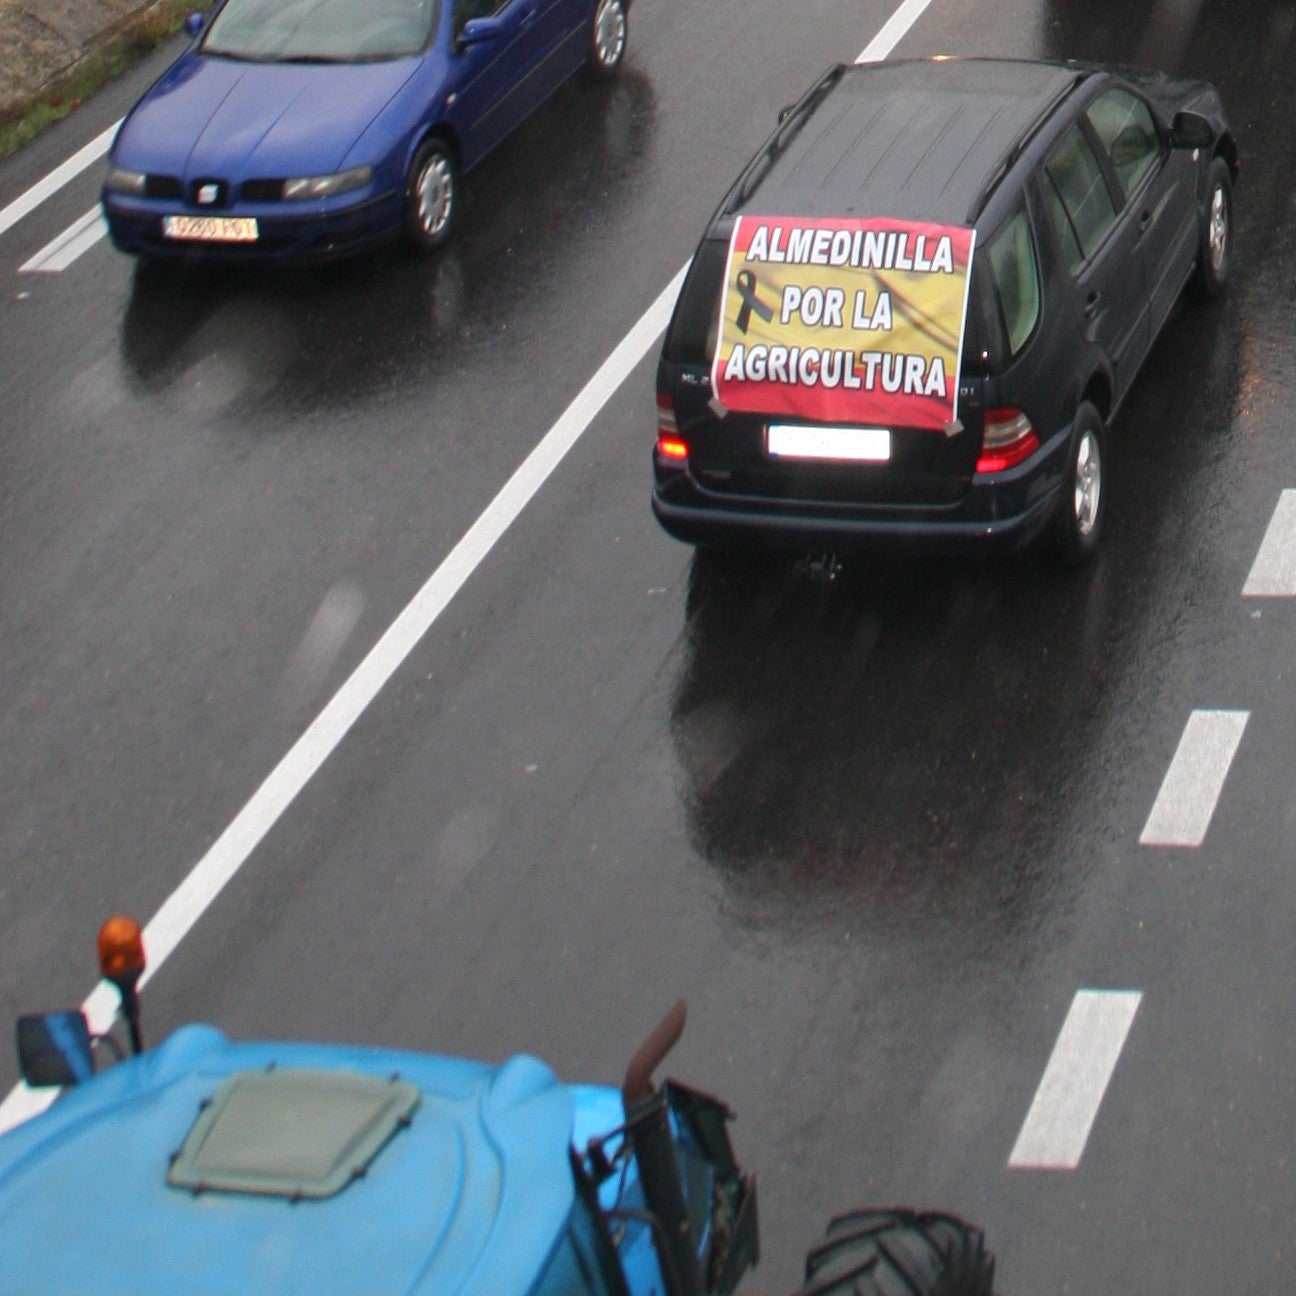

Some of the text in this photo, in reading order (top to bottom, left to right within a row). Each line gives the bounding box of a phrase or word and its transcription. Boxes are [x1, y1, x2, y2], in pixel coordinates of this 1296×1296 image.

[746, 224, 954, 274] ALMEDINILLA
[780, 284, 893, 331] POR LA
[723, 343, 946, 397] AGRICULTURA
